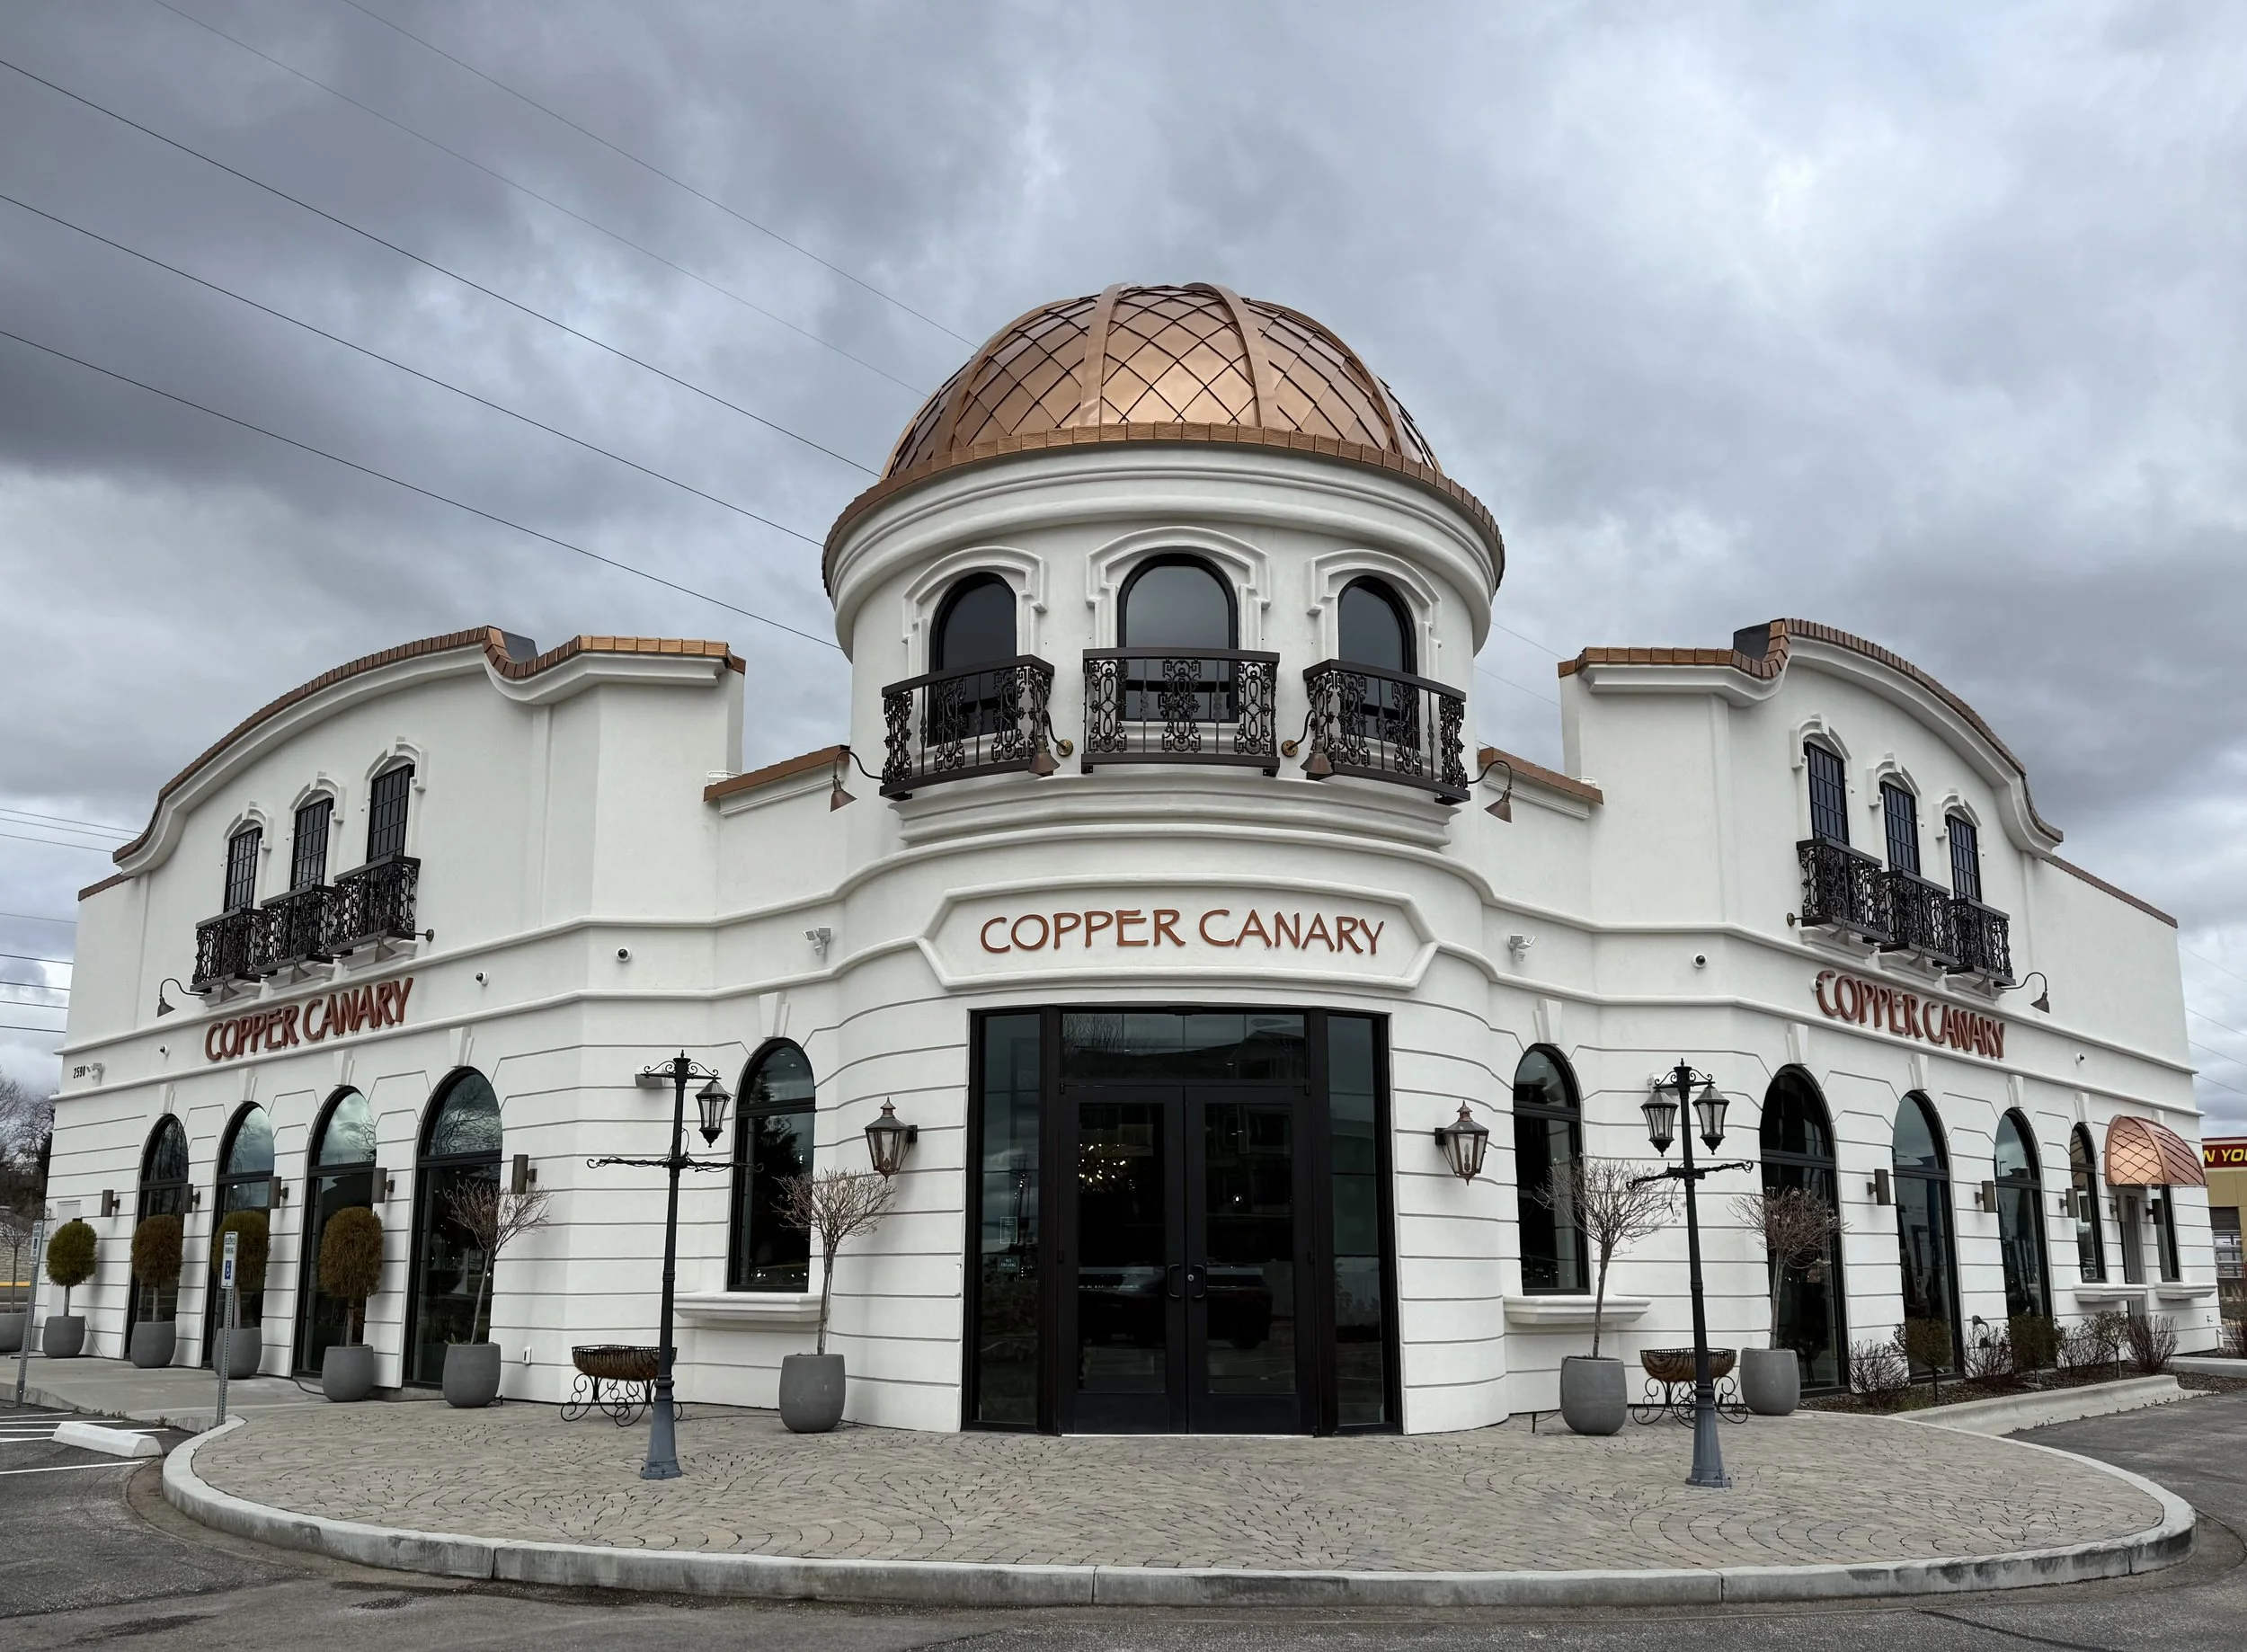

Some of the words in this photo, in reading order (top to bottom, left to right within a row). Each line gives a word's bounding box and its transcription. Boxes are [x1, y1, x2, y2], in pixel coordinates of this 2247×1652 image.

[981, 909, 1186, 954] COPPER
[1199, 909, 1385, 955] CANARY
[205, 1004, 299, 1061] COPPER
[302, 977, 414, 1040] CANARY
[1816, 970, 1924, 1038] COPPER
[1923, 1000, 2005, 1059] CANARY
[73, 1065, 86, 1079] 2590
[2221, 1148, 2247, 1162] YO
